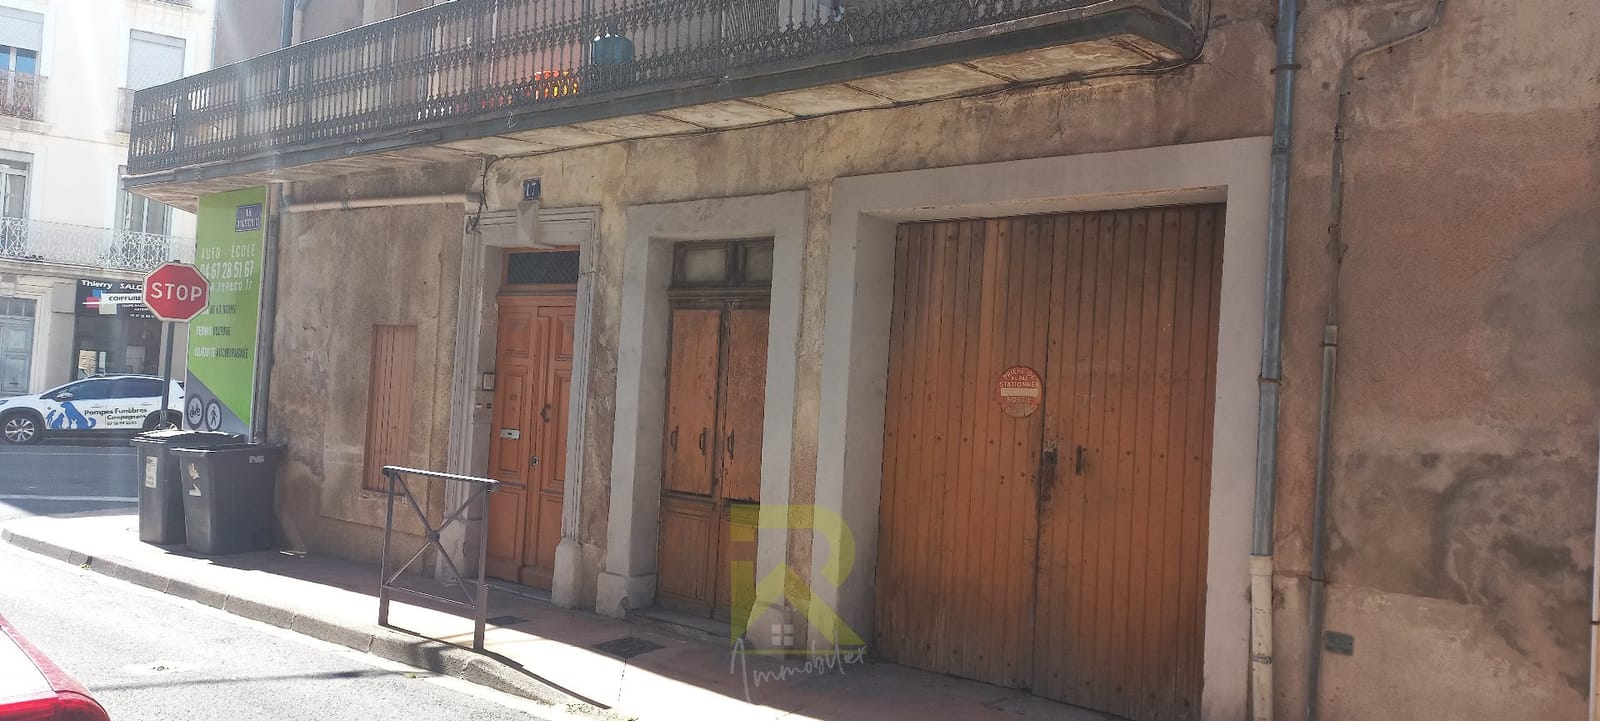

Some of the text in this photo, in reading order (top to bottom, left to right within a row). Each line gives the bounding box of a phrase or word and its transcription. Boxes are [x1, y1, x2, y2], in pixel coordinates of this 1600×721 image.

[526, 182, 537, 197] 17
[200, 241, 257, 260] AUTO ÉCOLE
[200, 260, 255, 279] 04 67 28 51 67
[81, 279, 143, 291] Thierry SALO
[150, 281, 203, 302] STOP
